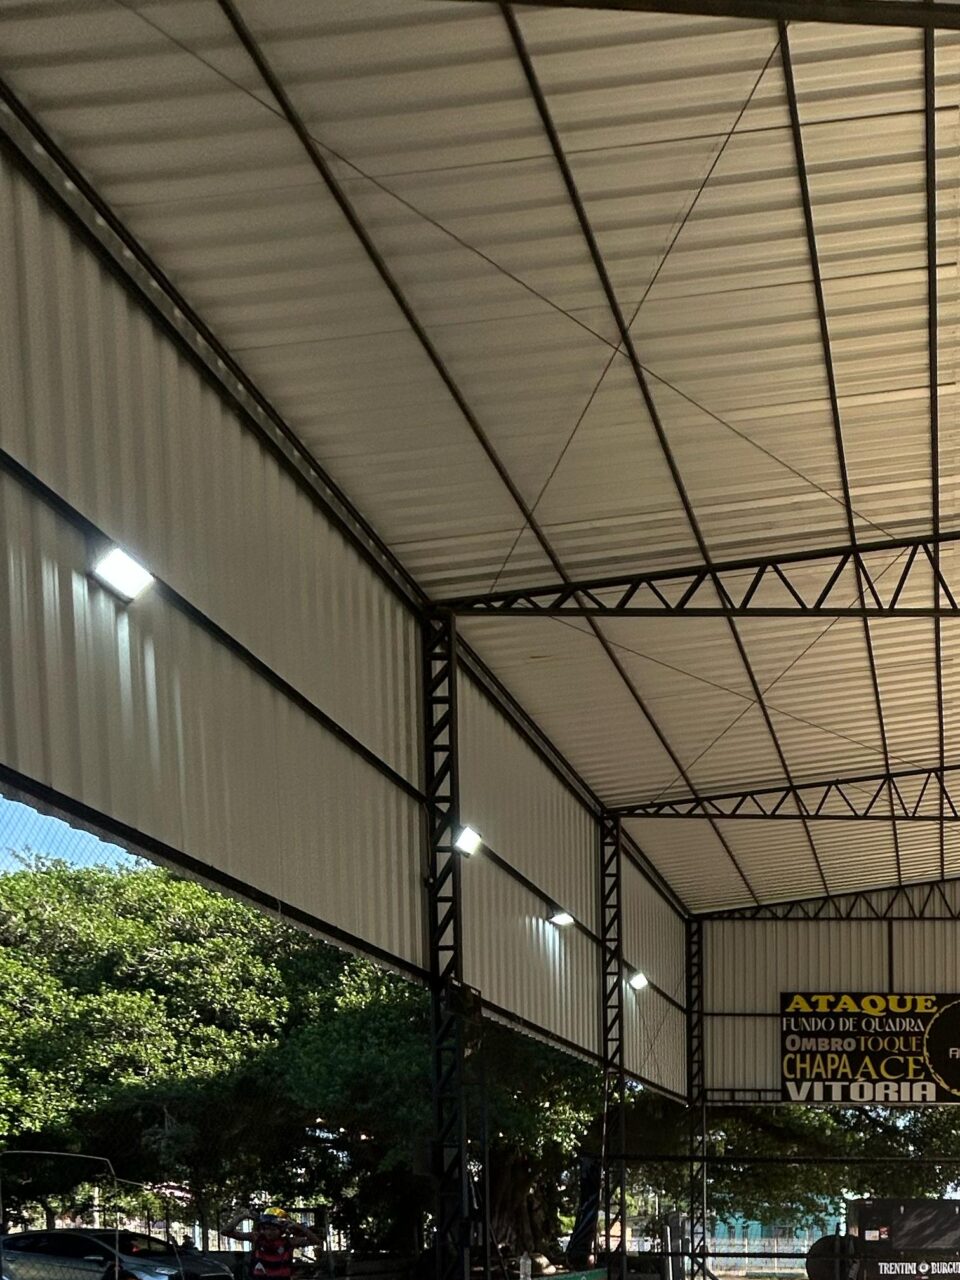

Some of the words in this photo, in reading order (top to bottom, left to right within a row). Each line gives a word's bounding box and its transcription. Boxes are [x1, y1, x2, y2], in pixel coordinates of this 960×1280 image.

[785, 994, 938, 1016] ATAQUE
[783, 1017, 835, 1032] FUNDO
[839, 1017, 857, 1032] DE
[861, 1017, 925, 1033] QUADRA
[856, 1036, 922, 1053] TOQUE
[783, 1053, 852, 1080] CHAPA
[852, 1055, 926, 1080] ACE
[785, 1078, 937, 1102] VITÓRIA
[878, 1262, 917, 1275] TRENTINI
